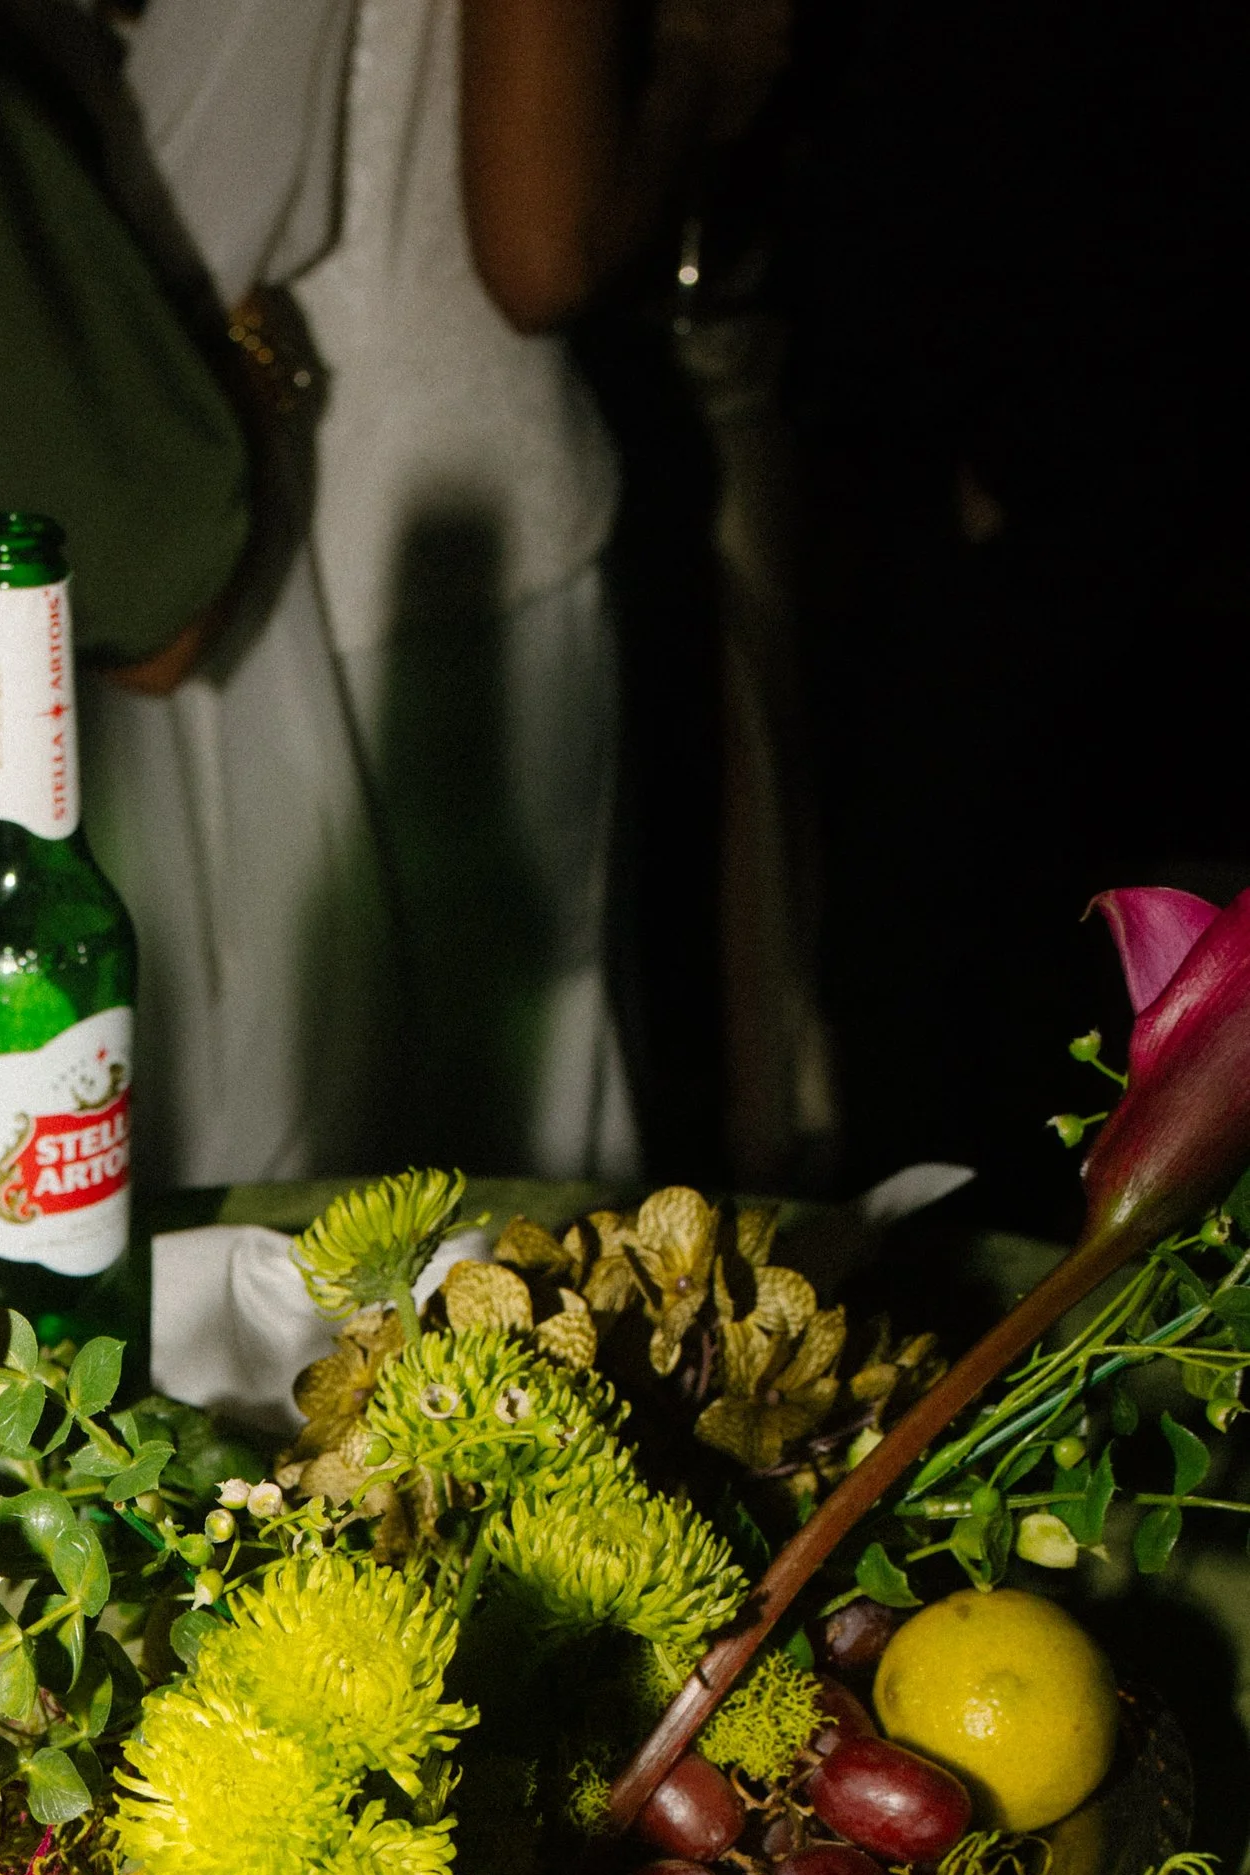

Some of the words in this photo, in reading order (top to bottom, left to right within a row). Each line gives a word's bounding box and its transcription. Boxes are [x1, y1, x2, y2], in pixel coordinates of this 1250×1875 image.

[49, 597, 62, 690] ARTOIS
[52, 732, 66, 821] STELLA
[32, 1146, 130, 1197] ARTO
[35, 1112, 128, 1166] STELL
